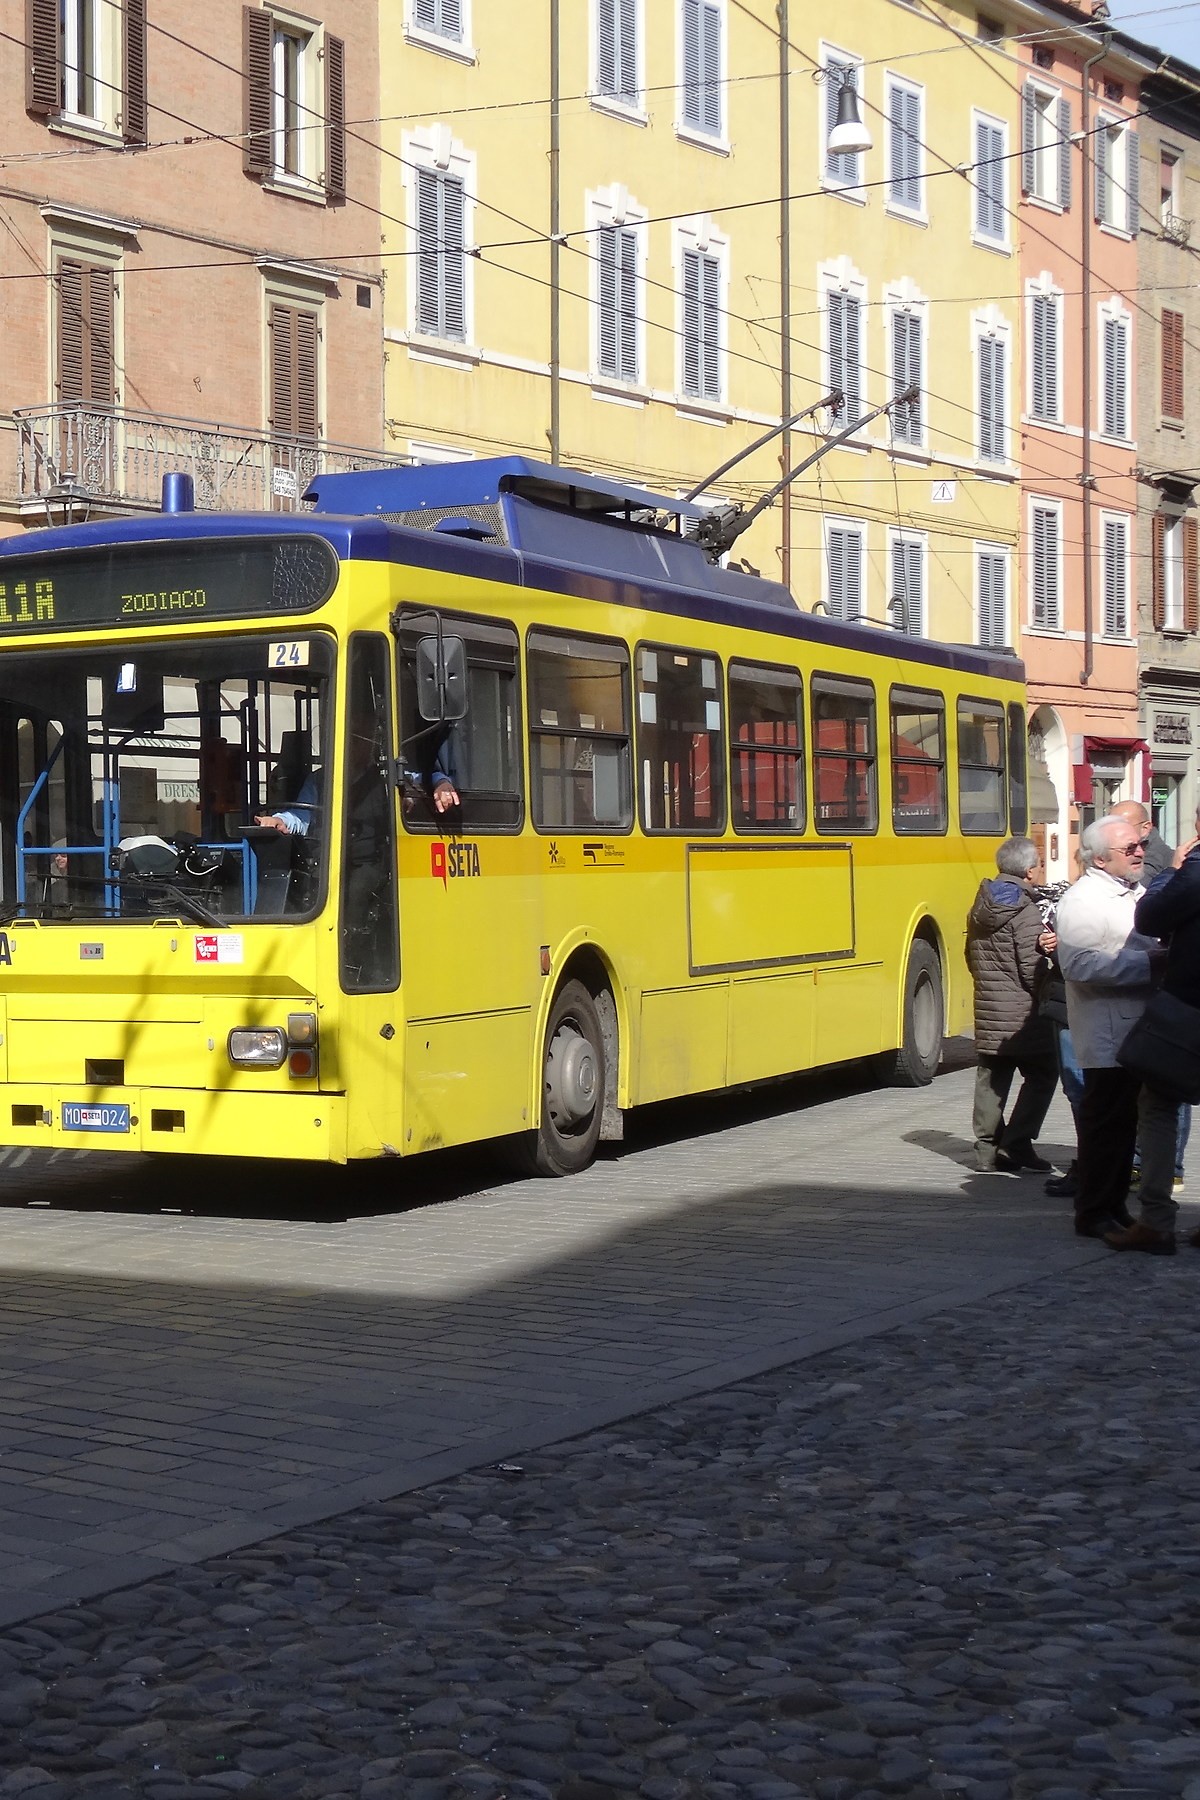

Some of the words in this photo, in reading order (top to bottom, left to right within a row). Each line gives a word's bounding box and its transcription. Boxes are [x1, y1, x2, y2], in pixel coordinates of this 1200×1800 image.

[121, 589, 206, 613] ZODIACO
[276, 644, 299, 666] 24
[448, 843, 480, 877] SETA
[65, 1108, 80, 1124] MO
[102, 1109, 126, 1126] 024
